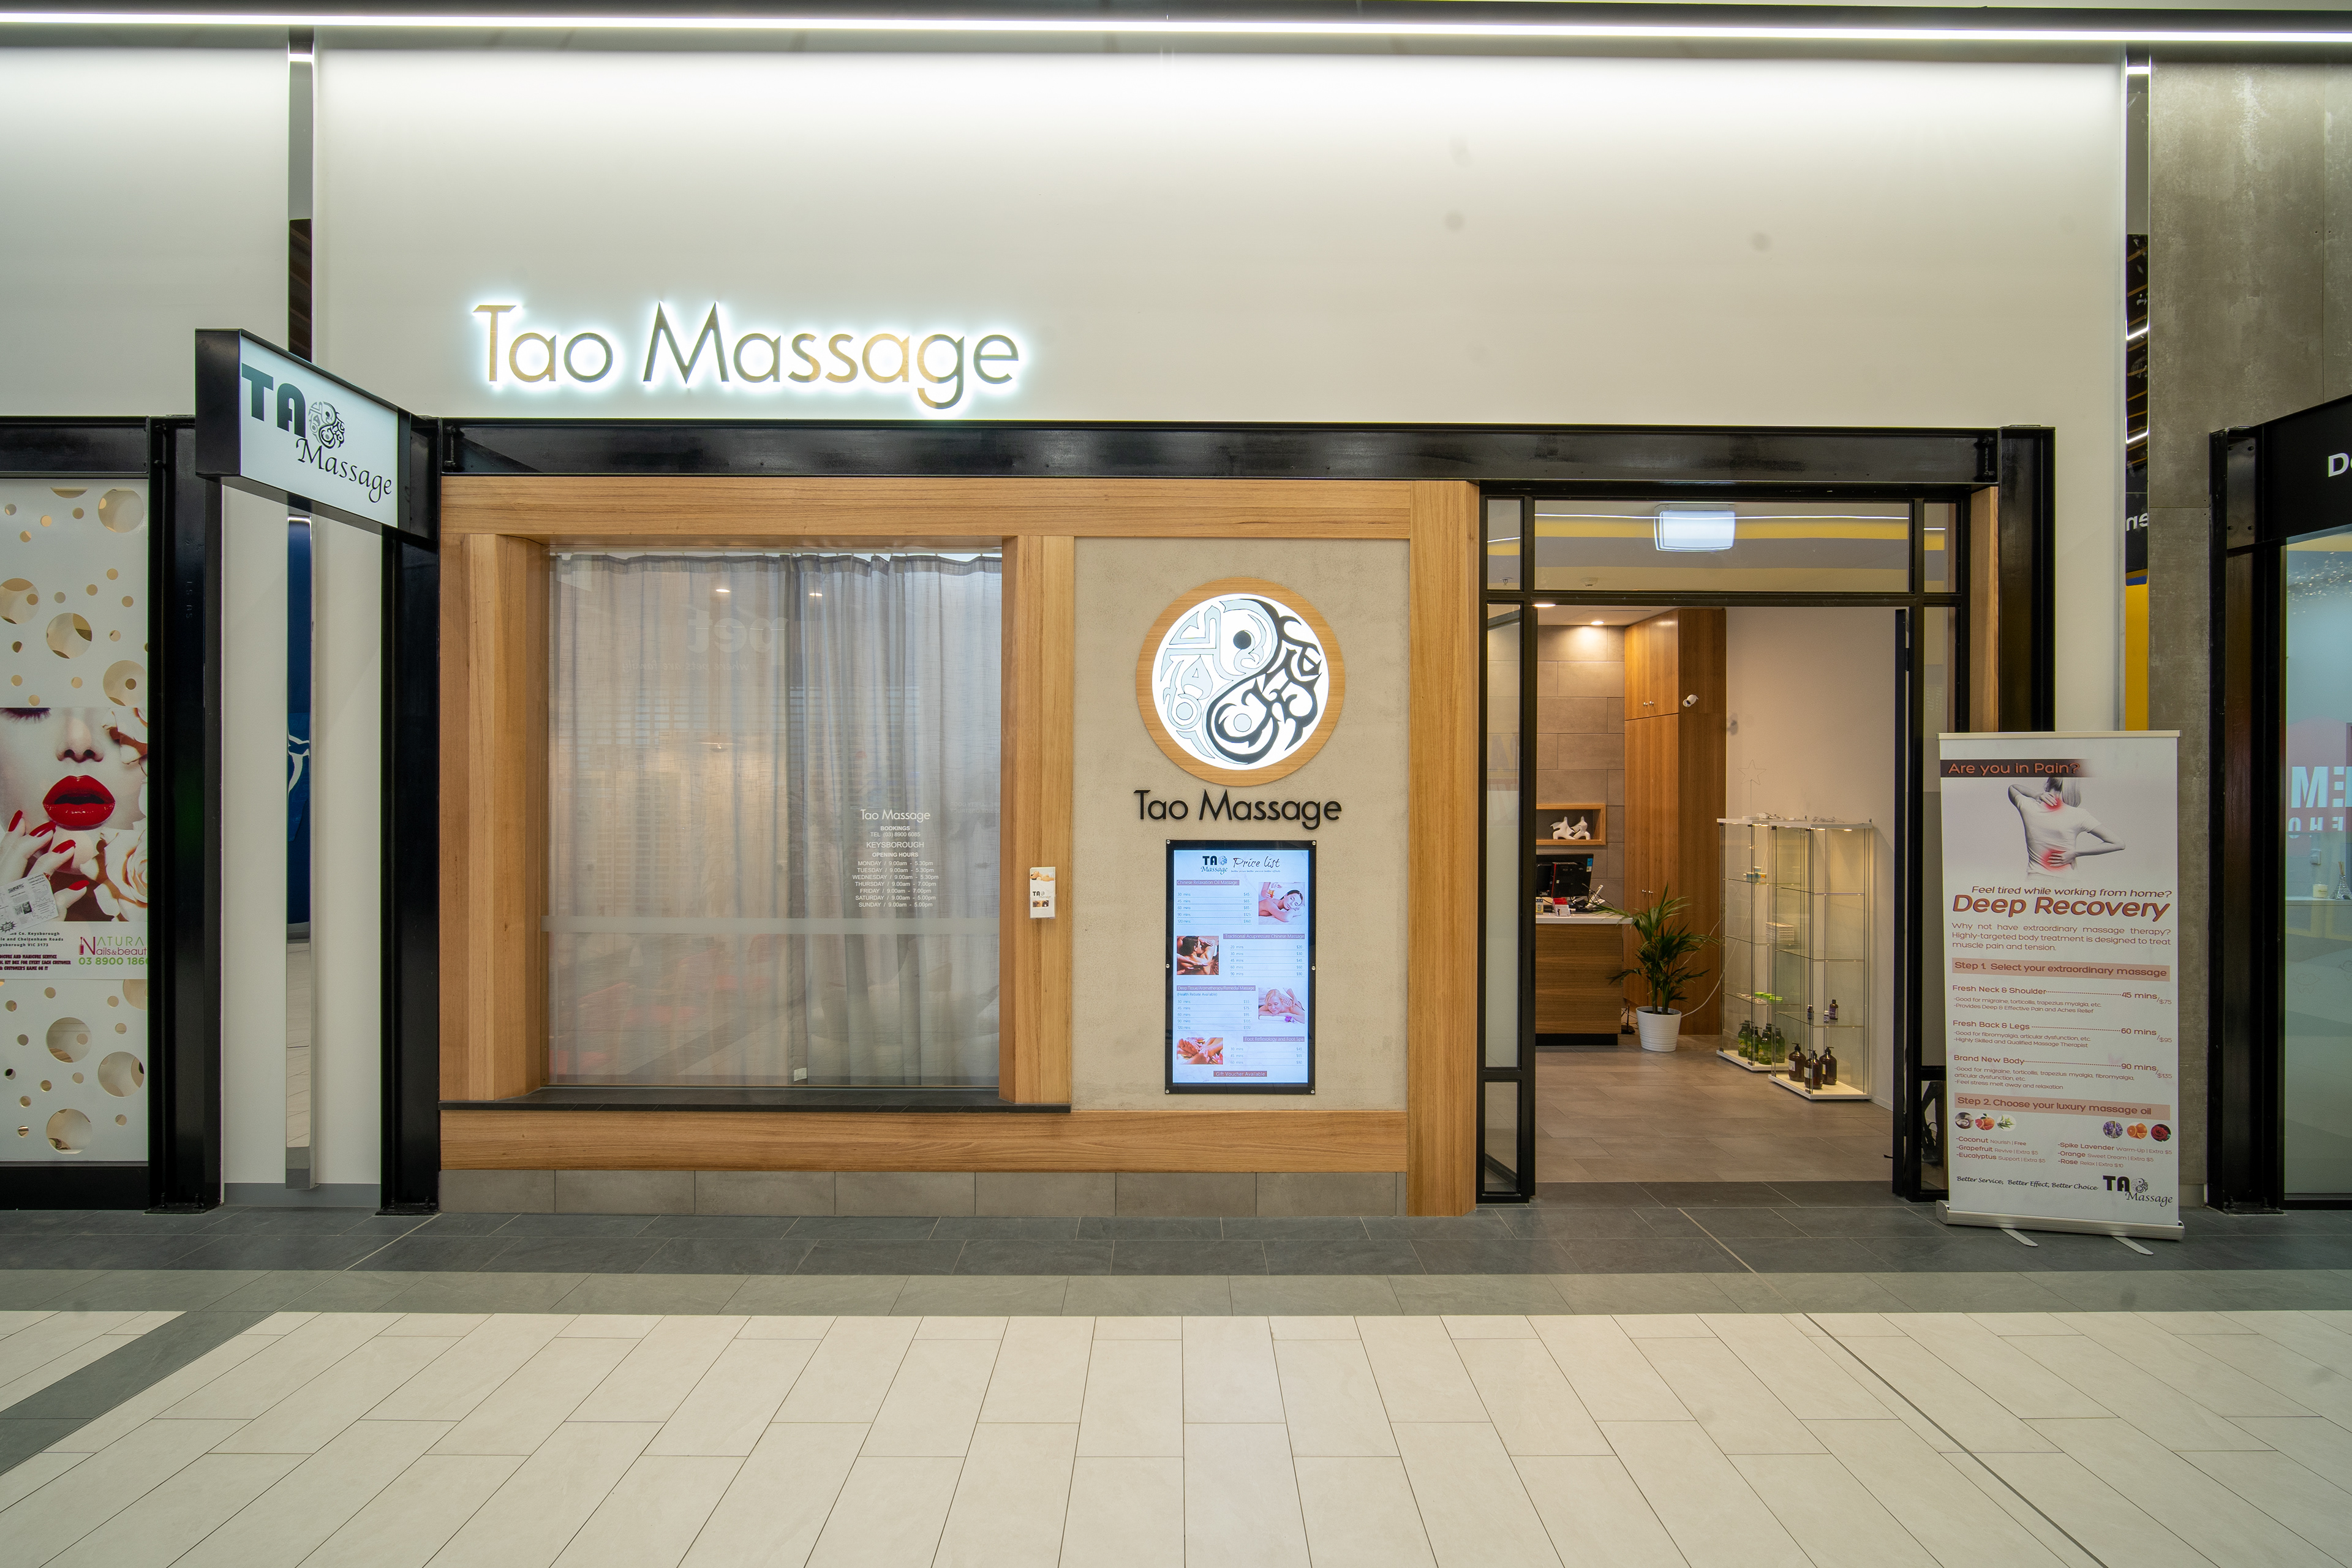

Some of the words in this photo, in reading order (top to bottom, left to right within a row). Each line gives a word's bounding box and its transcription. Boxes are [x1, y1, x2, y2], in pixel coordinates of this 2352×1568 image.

[473, 304, 613, 383] Tao
[643, 301, 1019, 410] Massage
[296, 438, 391, 503] Massage
[1949, 763, 1975, 774] Are
[1981, 764, 2010, 775] you
[2016, 763, 2029, 773] in
[2035, 763, 2080, 774] Pain?
[861, 809, 878, 820] Tao
[882, 809, 930, 823] Massage
[1134, 790, 1188, 820] Tao
[1199, 789, 1342, 830] Massage
[1233, 858, 1260, 869] Price
[1264, 856, 1280, 868] list
[1200, 865, 1227, 875] Massage
[2054, 888, 2096, 897] working
[1953, 894, 2026, 917] Deep
[2035, 897, 2170, 922] Recovery
[2023, 925, 2077, 933] extraordinary
[2082, 926, 2124, 935] massage
[2130, 927, 2171, 936] therapy?
[1952, 932, 2016, 941] Highly-targeted
[2019, 933, 2039, 942] body
[2095, 936, 2136, 944] designed
[1954, 962, 1978, 970] Step
[2048, 965, 2113, 976] extraordinary
[2117, 968, 2166, 978] massage
[2157, 997, 2172, 1005] /$75
[2155, 1069, 2172, 1079] /$135
[1958, 1097, 1981, 1106] Step
[1993, 1099, 2030, 1108] Choose
[2033, 1101, 2054, 1110] your
[2057, 1102, 2086, 1112] luxury
[2089, 1104, 2137, 1115] massage
[2125, 1191, 2173, 1207] Massage
